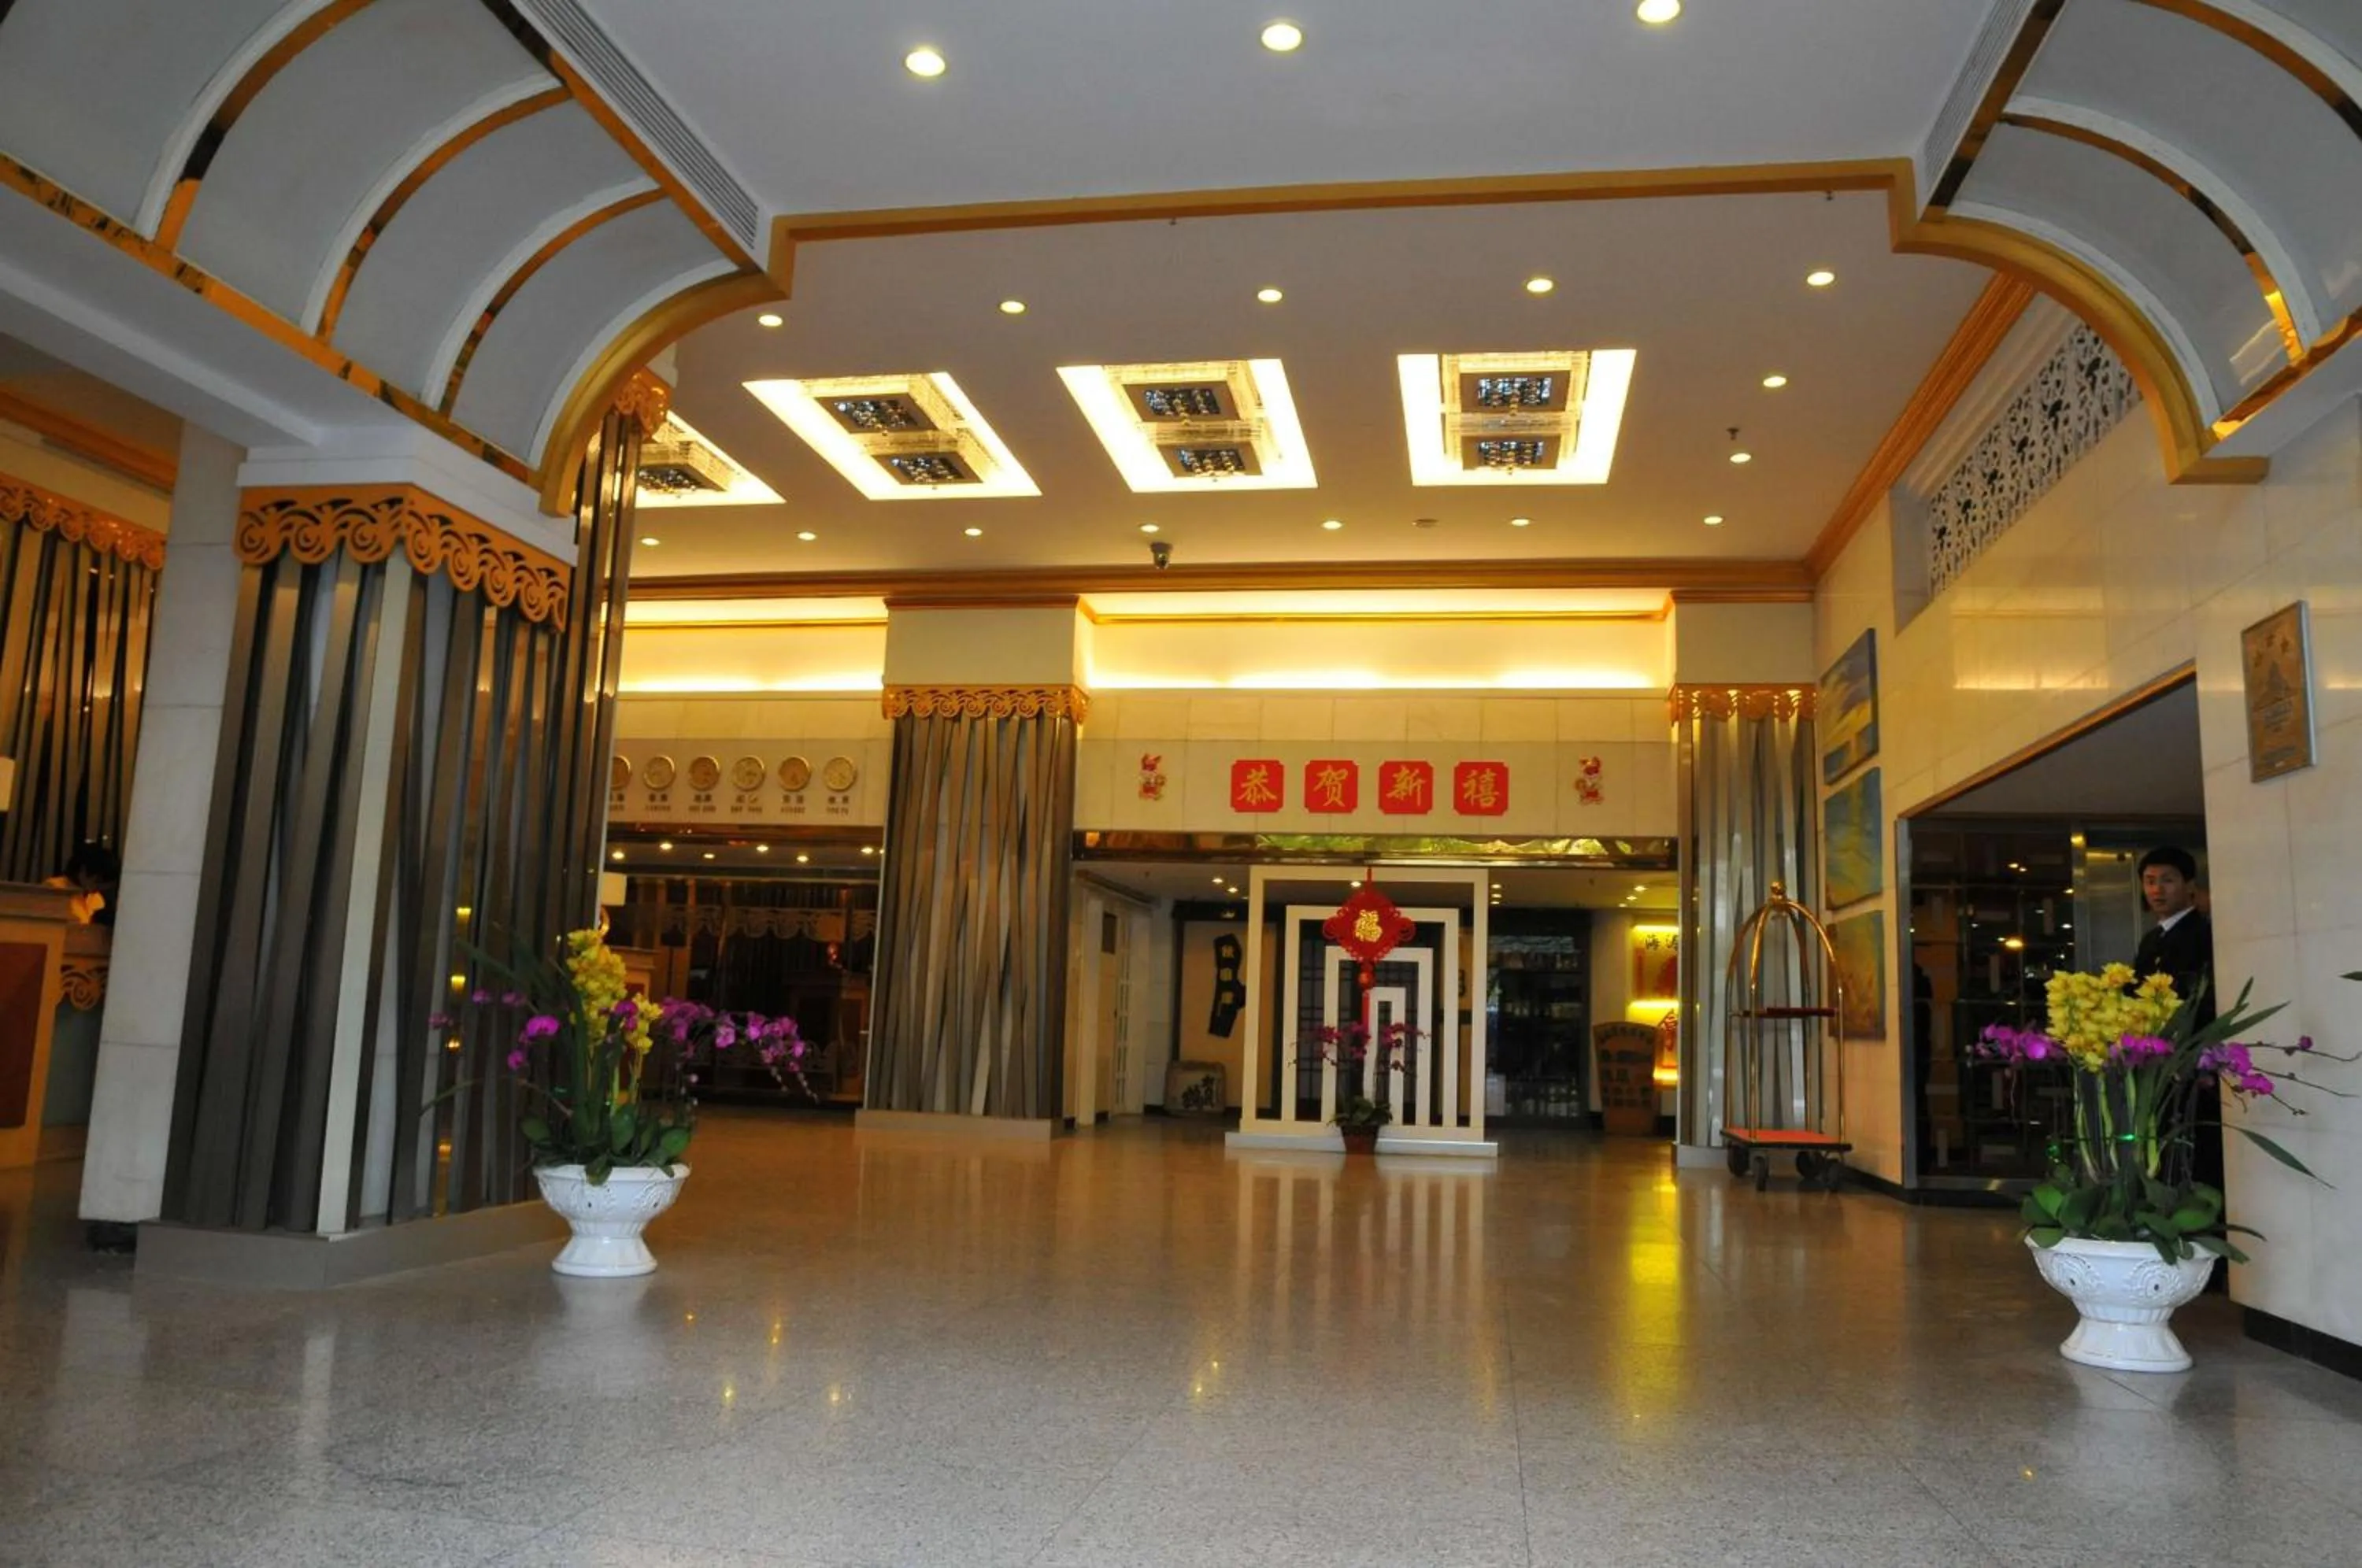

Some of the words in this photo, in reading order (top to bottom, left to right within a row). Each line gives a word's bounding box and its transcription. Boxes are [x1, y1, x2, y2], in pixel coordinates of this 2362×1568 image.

[1237, 764, 1500, 808] 恭贺新禧
[1354, 909, 1383, 942] 福
